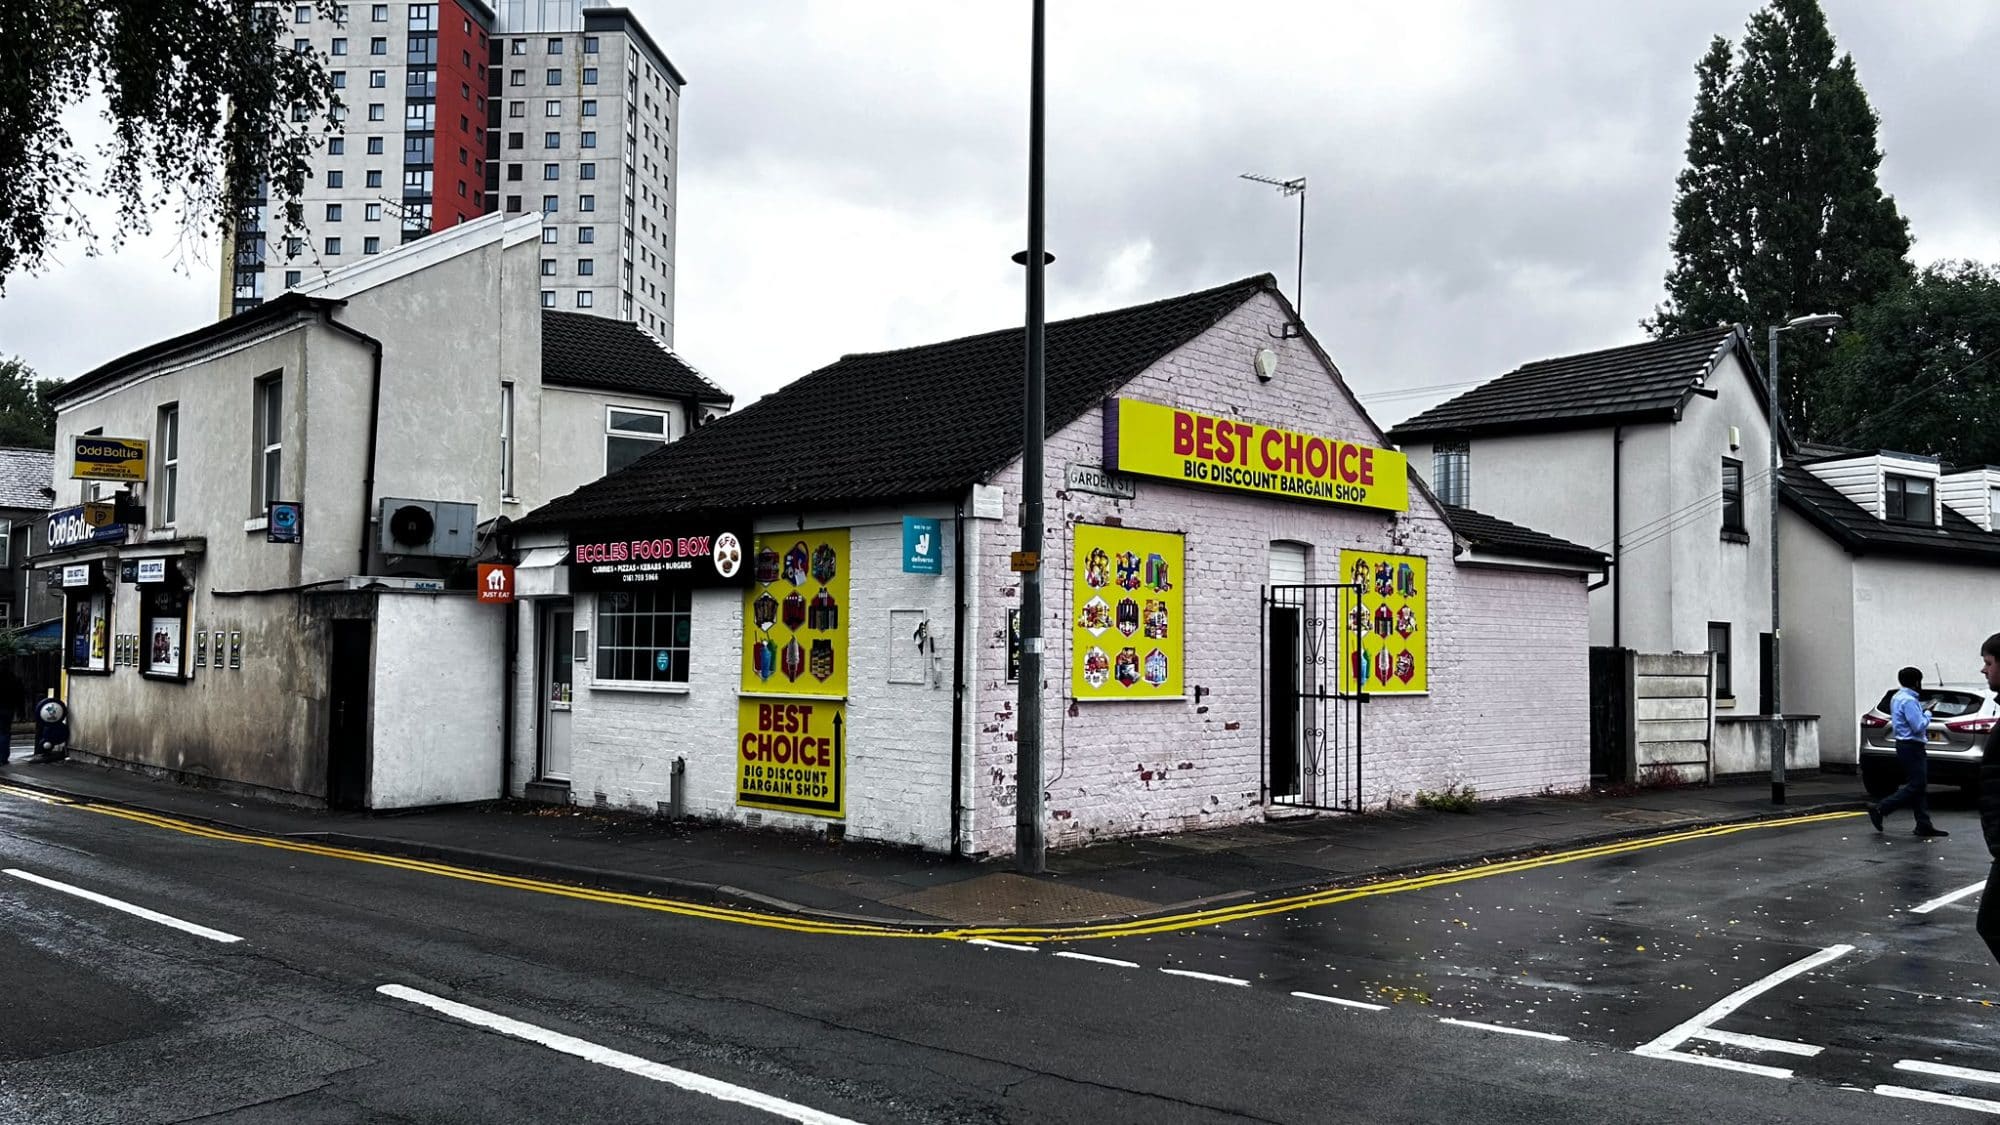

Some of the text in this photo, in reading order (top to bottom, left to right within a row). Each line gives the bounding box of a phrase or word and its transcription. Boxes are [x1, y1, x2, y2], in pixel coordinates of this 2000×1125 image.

[77, 445, 138, 458] Odd Bottle
[1173, 411, 1374, 486] BEST CHOICE
[1070, 471, 1114, 489] GARDEN
[1184, 460, 1366, 502] BIG DISCOUNT BARGAIN SHOP
[48, 516, 67, 547] Odd
[718, 536, 737, 549] EFB
[576, 536, 711, 563] ECCLES FOOD BOX
[617, 564, 636, 573] PIZZAS
[640, 562, 662, 571] KEBABS
[665, 561, 692, 570] BURGERS
[758, 703, 813, 734] BEST
[741, 732, 831, 767] CHOICE
[744, 764, 827, 784] BIG DISCOUNT
[742, 778, 829, 798] BARGAIN SHOP
